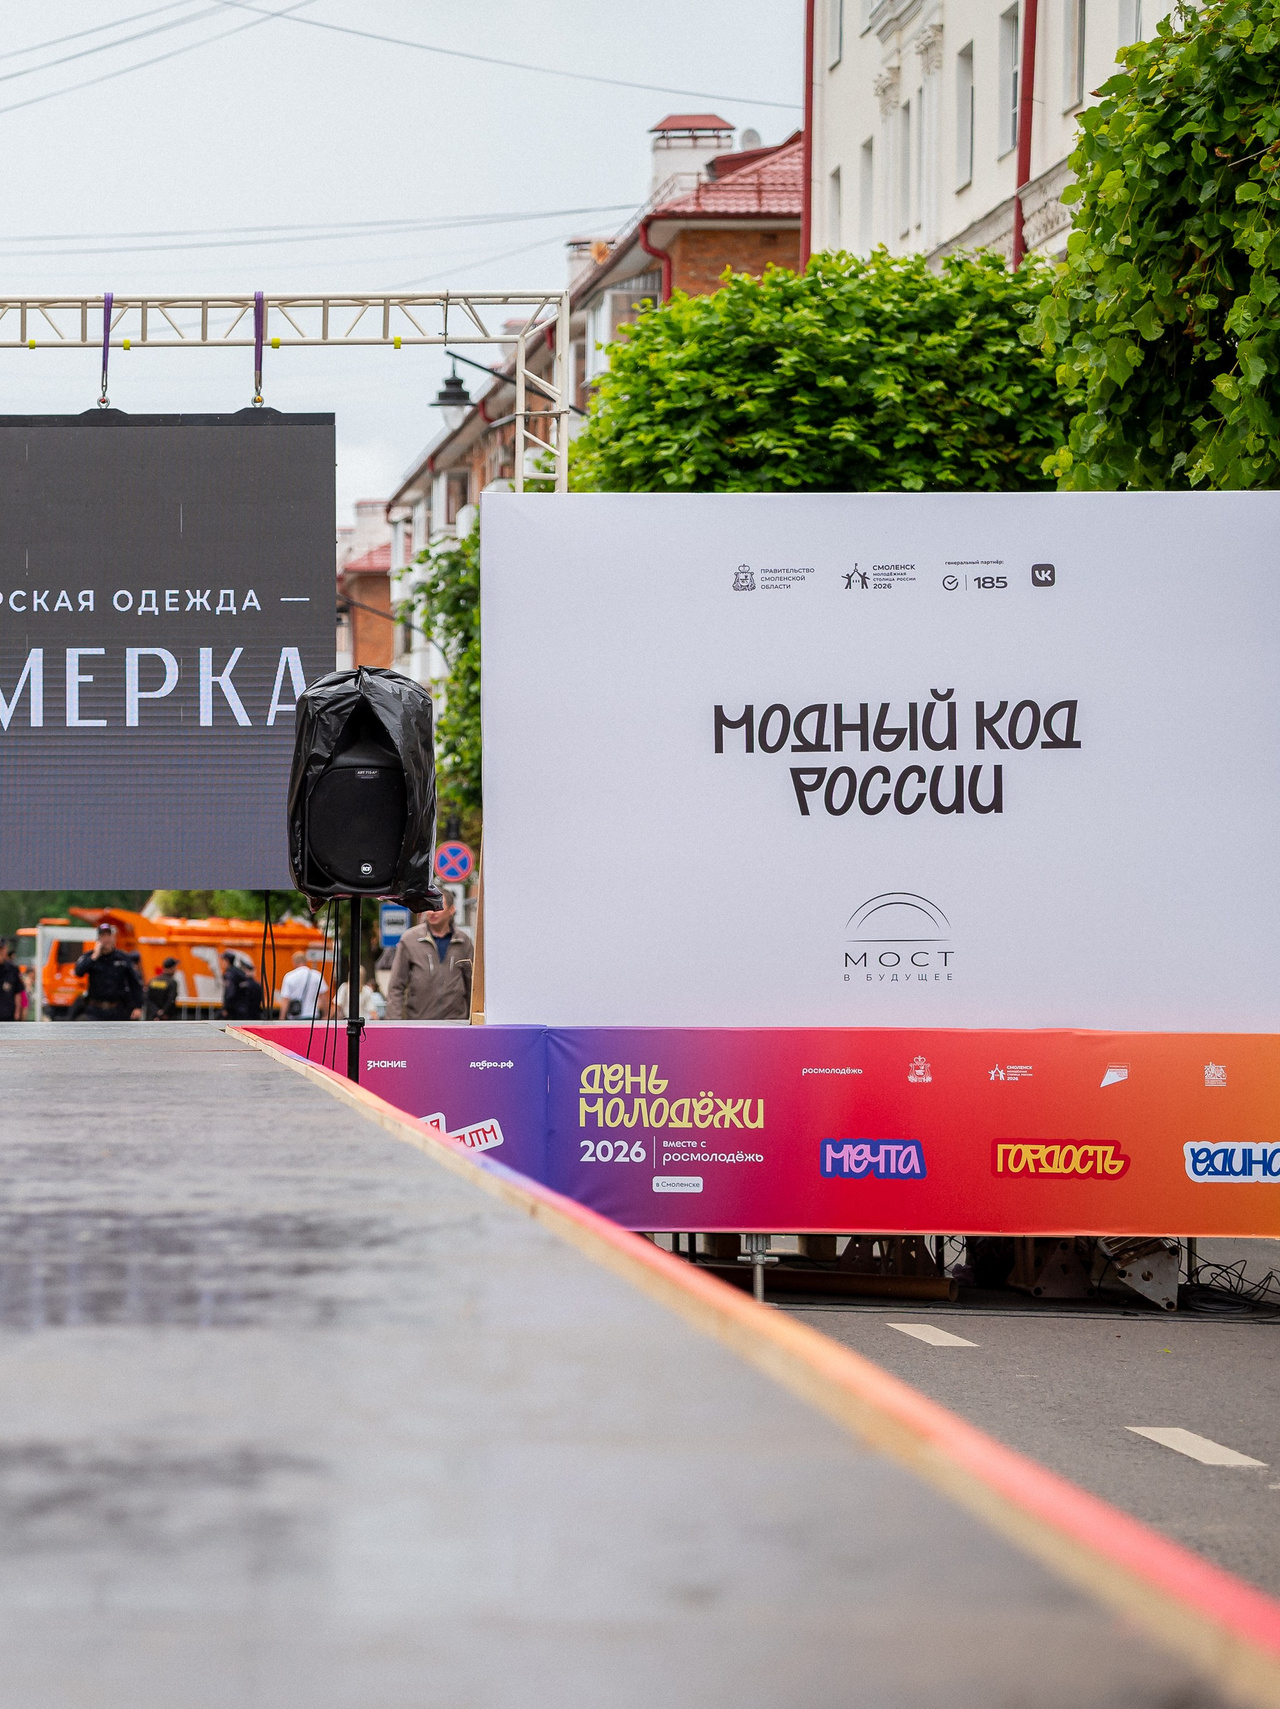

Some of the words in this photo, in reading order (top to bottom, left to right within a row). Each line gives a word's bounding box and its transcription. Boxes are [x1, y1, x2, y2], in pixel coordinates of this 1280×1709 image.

[973, 576, 1008, 589] 185
[1034, 570, 1052, 582] VK
[112, 588, 262, 616] ОДЕЖДА
[713, 688, 958, 754] МОДНЫЙ
[975, 699, 1082, 750] КОД
[789, 764, 1004, 816] РОССИИ
[844, 951, 955, 968] МОСТ
[866, 973, 953, 982] БУДУЩЕЕ
[469, 1060, 514, 1070] добро.рф
[802, 1066, 863, 1076] росмолодёжь
[579, 1091, 765, 1129] МОЛОДЁЖИ
[579, 1139, 647, 1163] 2026
[662, 1140, 698, 1148] вместе
[700, 1140, 707, 1148] с
[662, 1151, 764, 1166] росмолодёжь
[996, 1143, 1125, 1175] ГОРДОСТЬ
